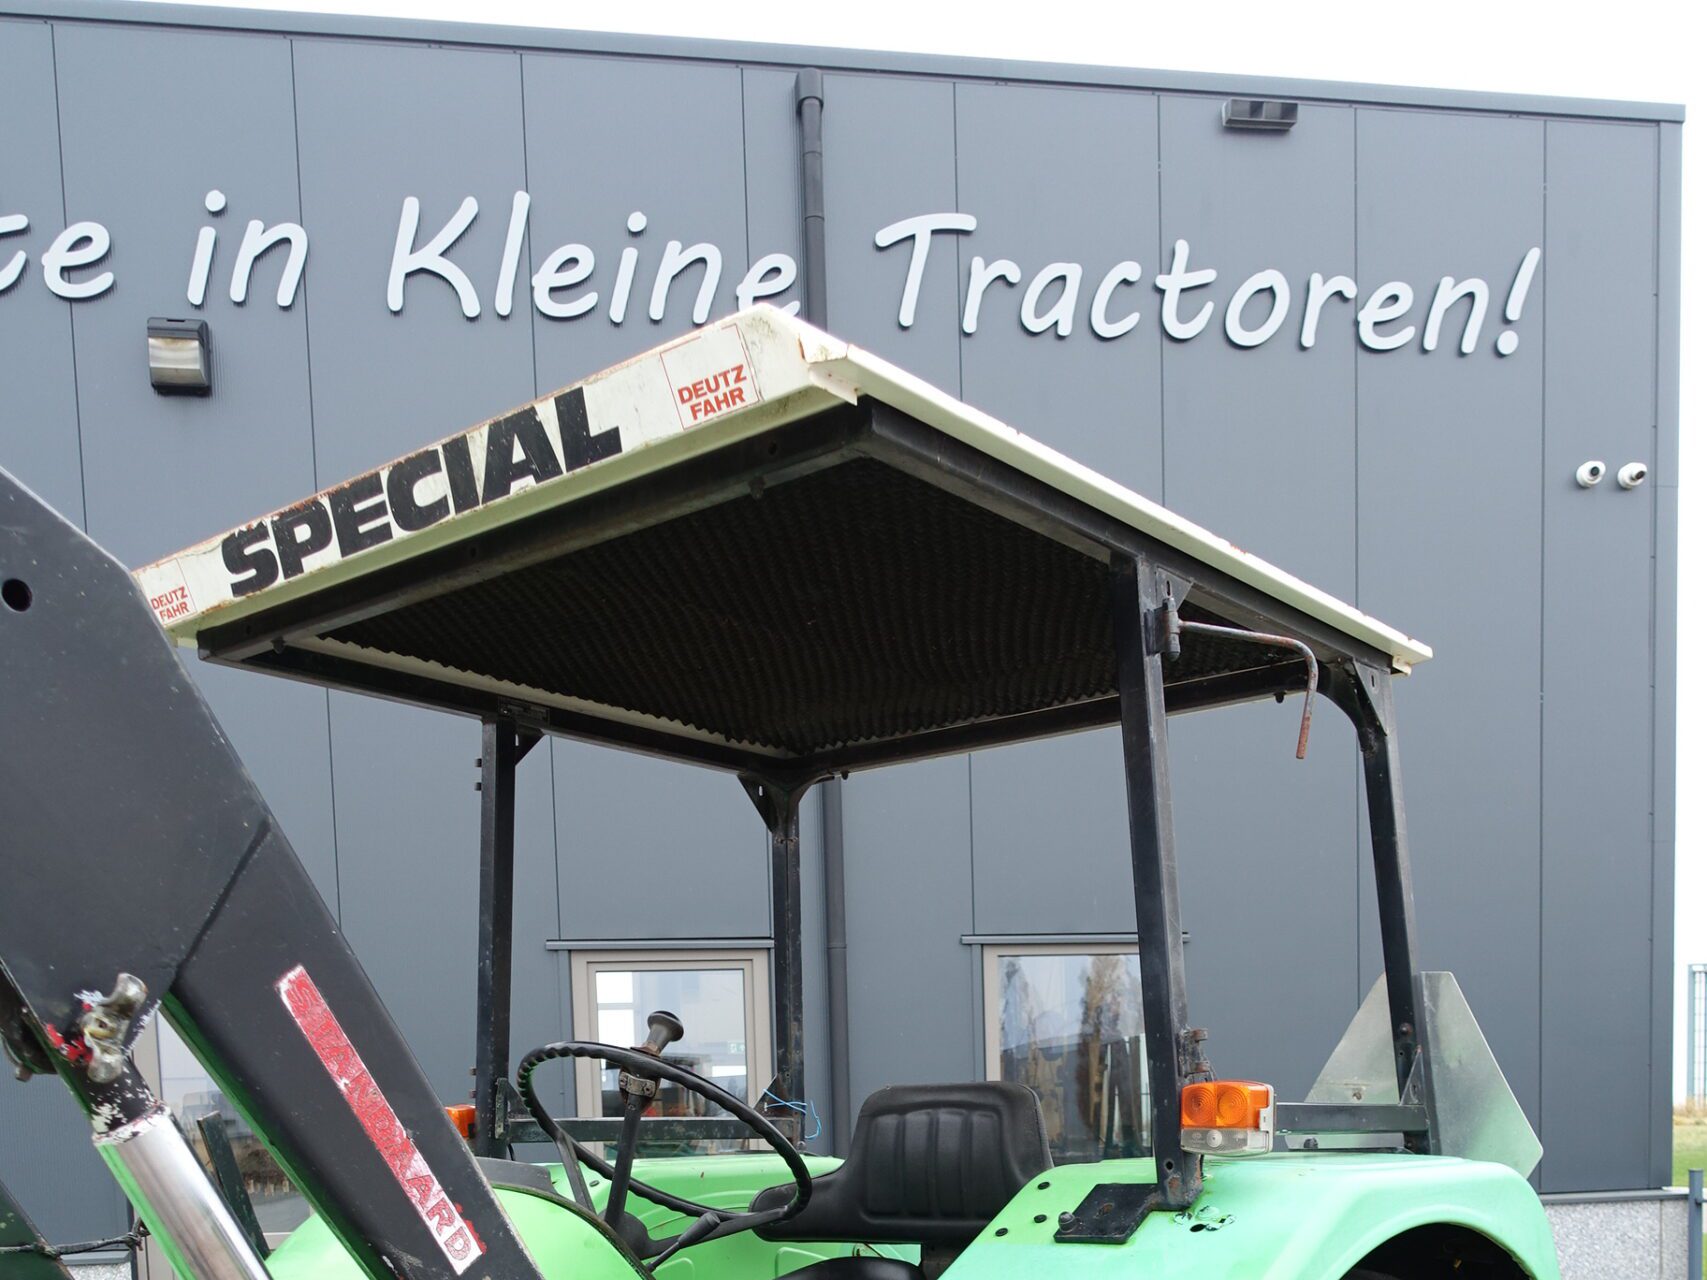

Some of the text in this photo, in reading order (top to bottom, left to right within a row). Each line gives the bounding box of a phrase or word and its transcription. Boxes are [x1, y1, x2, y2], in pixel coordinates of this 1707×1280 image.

[187, 190, 308, 307] in
[387, 190, 800, 325] Kleine
[871, 213, 1541, 355] Tractoren!
[677, 363, 748, 405] DEUTZ
[689, 386, 746, 422] FAHR
[221, 386, 623, 598] SPECIAL
[150, 585, 188, 610] DEUTZ
[159, 601, 190, 622] FAHR
